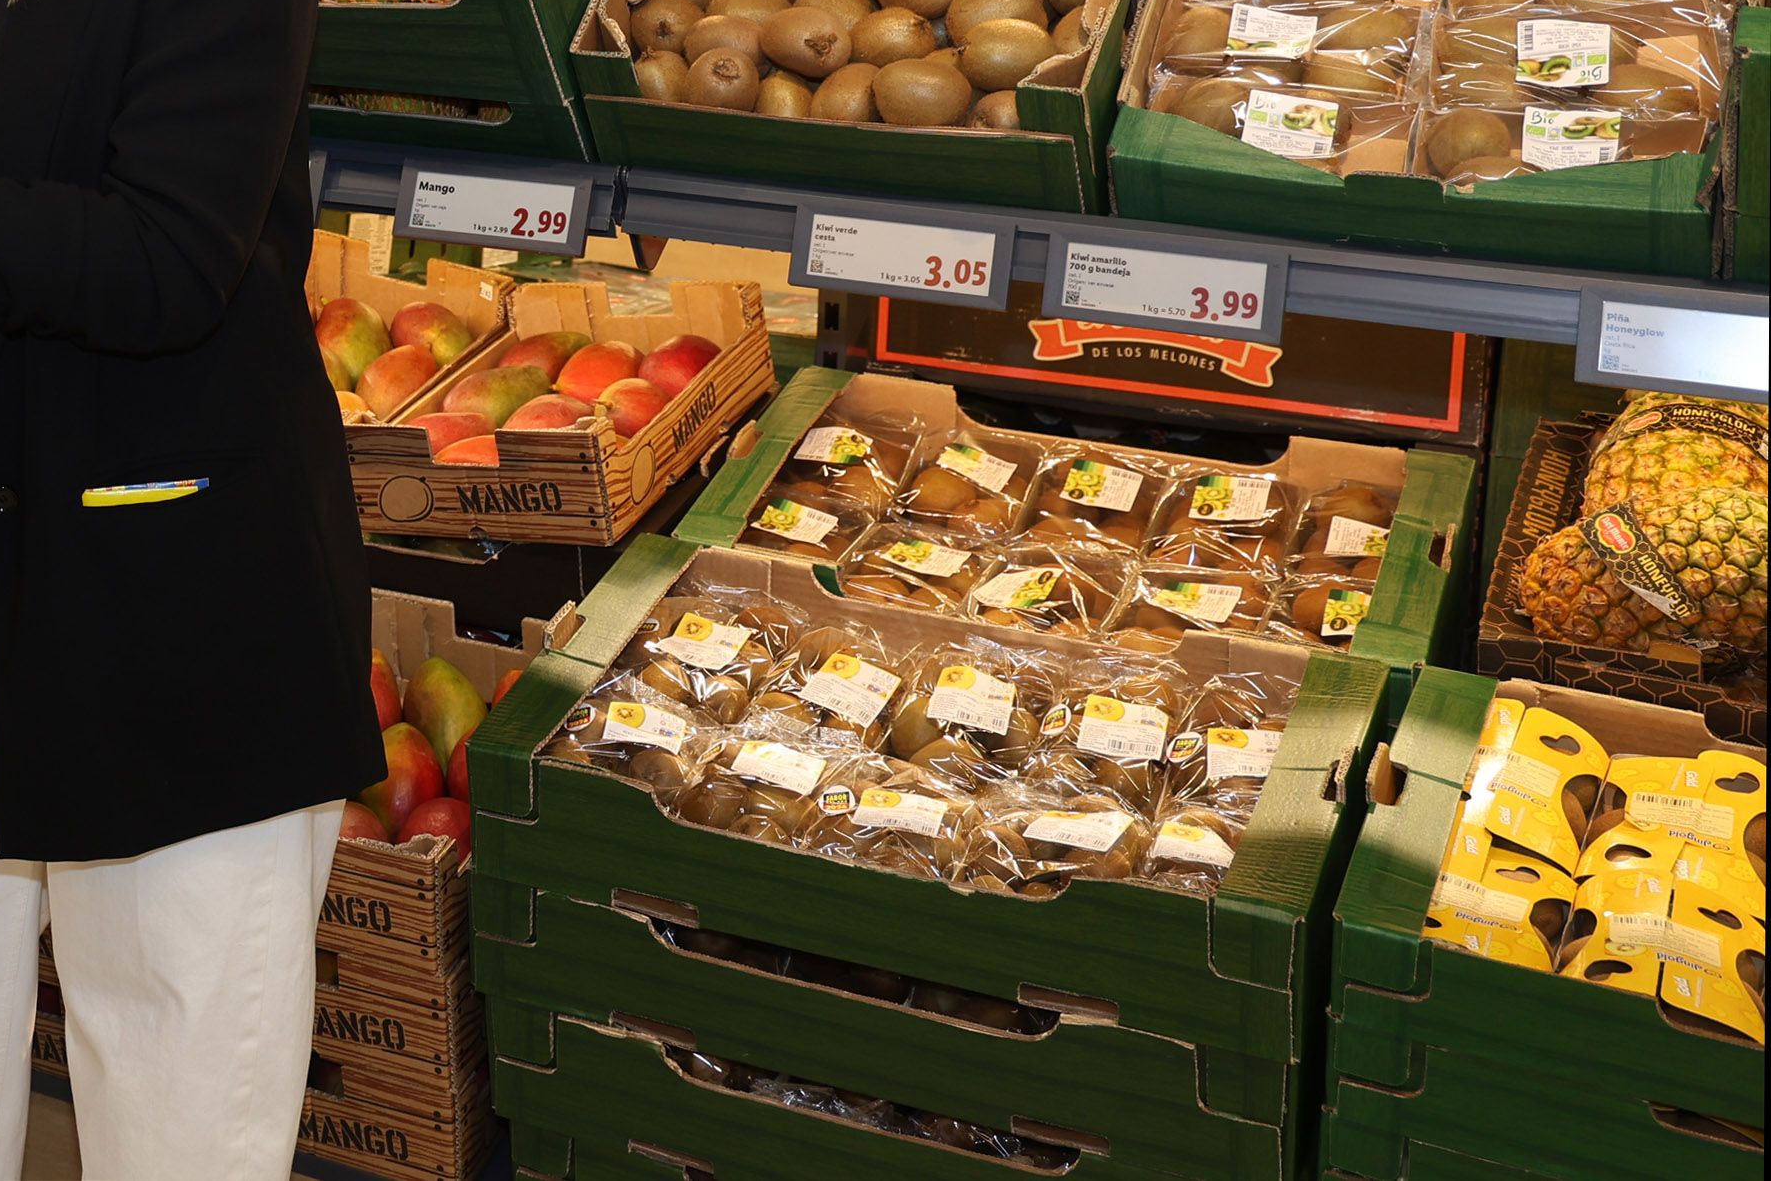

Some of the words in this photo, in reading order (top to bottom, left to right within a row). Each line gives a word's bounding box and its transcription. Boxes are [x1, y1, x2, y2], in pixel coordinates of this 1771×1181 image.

[1580, 66, 1603, 81] Bio
[1532, 111, 1554, 125] Bio
[418, 181, 456, 195] Mango
[473, 223, 477, 231] 1
[477, 223, 487, 232] kg
[493, 226, 508, 234] 2.99
[510, 207, 568, 238] 2.99
[815, 223, 834, 233] Kiwi
[835, 226, 858, 235] verde
[814, 233, 836, 242] cesta
[1070, 252, 1090, 262] Kiwi
[1091, 255, 1127, 267] amarillo
[881, 272, 884, 280] 1
[886, 273, 896, 282] kg
[903, 275, 921, 284] 3.05
[924, 255, 987, 289] 3.05
[1069, 263, 1086, 272] 700
[1087, 266, 1095, 274] g
[1095, 266, 1131, 277] bandeja
[1143, 304, 1146, 312] 1
[1148, 304, 1159, 315] kg
[1167, 306, 1186, 317] 5.70
[1190, 287, 1258, 322] 3.99
[1607, 312, 1630, 323] Piña
[1605, 323, 1665, 338] Honeyglow
[1092, 347, 1109, 358] DE
[1117, 347, 1142, 358] LOS
[1149, 348, 1216, 371] MELONES
[671, 381, 717, 453] MANGO
[1673, 407, 1756, 435] HONEYGLOW
[456, 481, 563, 514] MANGO
[1522, 449, 1572, 540] HONEYGLOW
[1464, 834, 1479, 855] Gold
[319, 893, 393, 933] NGO
[316, 1006, 406, 1052] ANGO
[299, 1112, 409, 1161] MANGO
